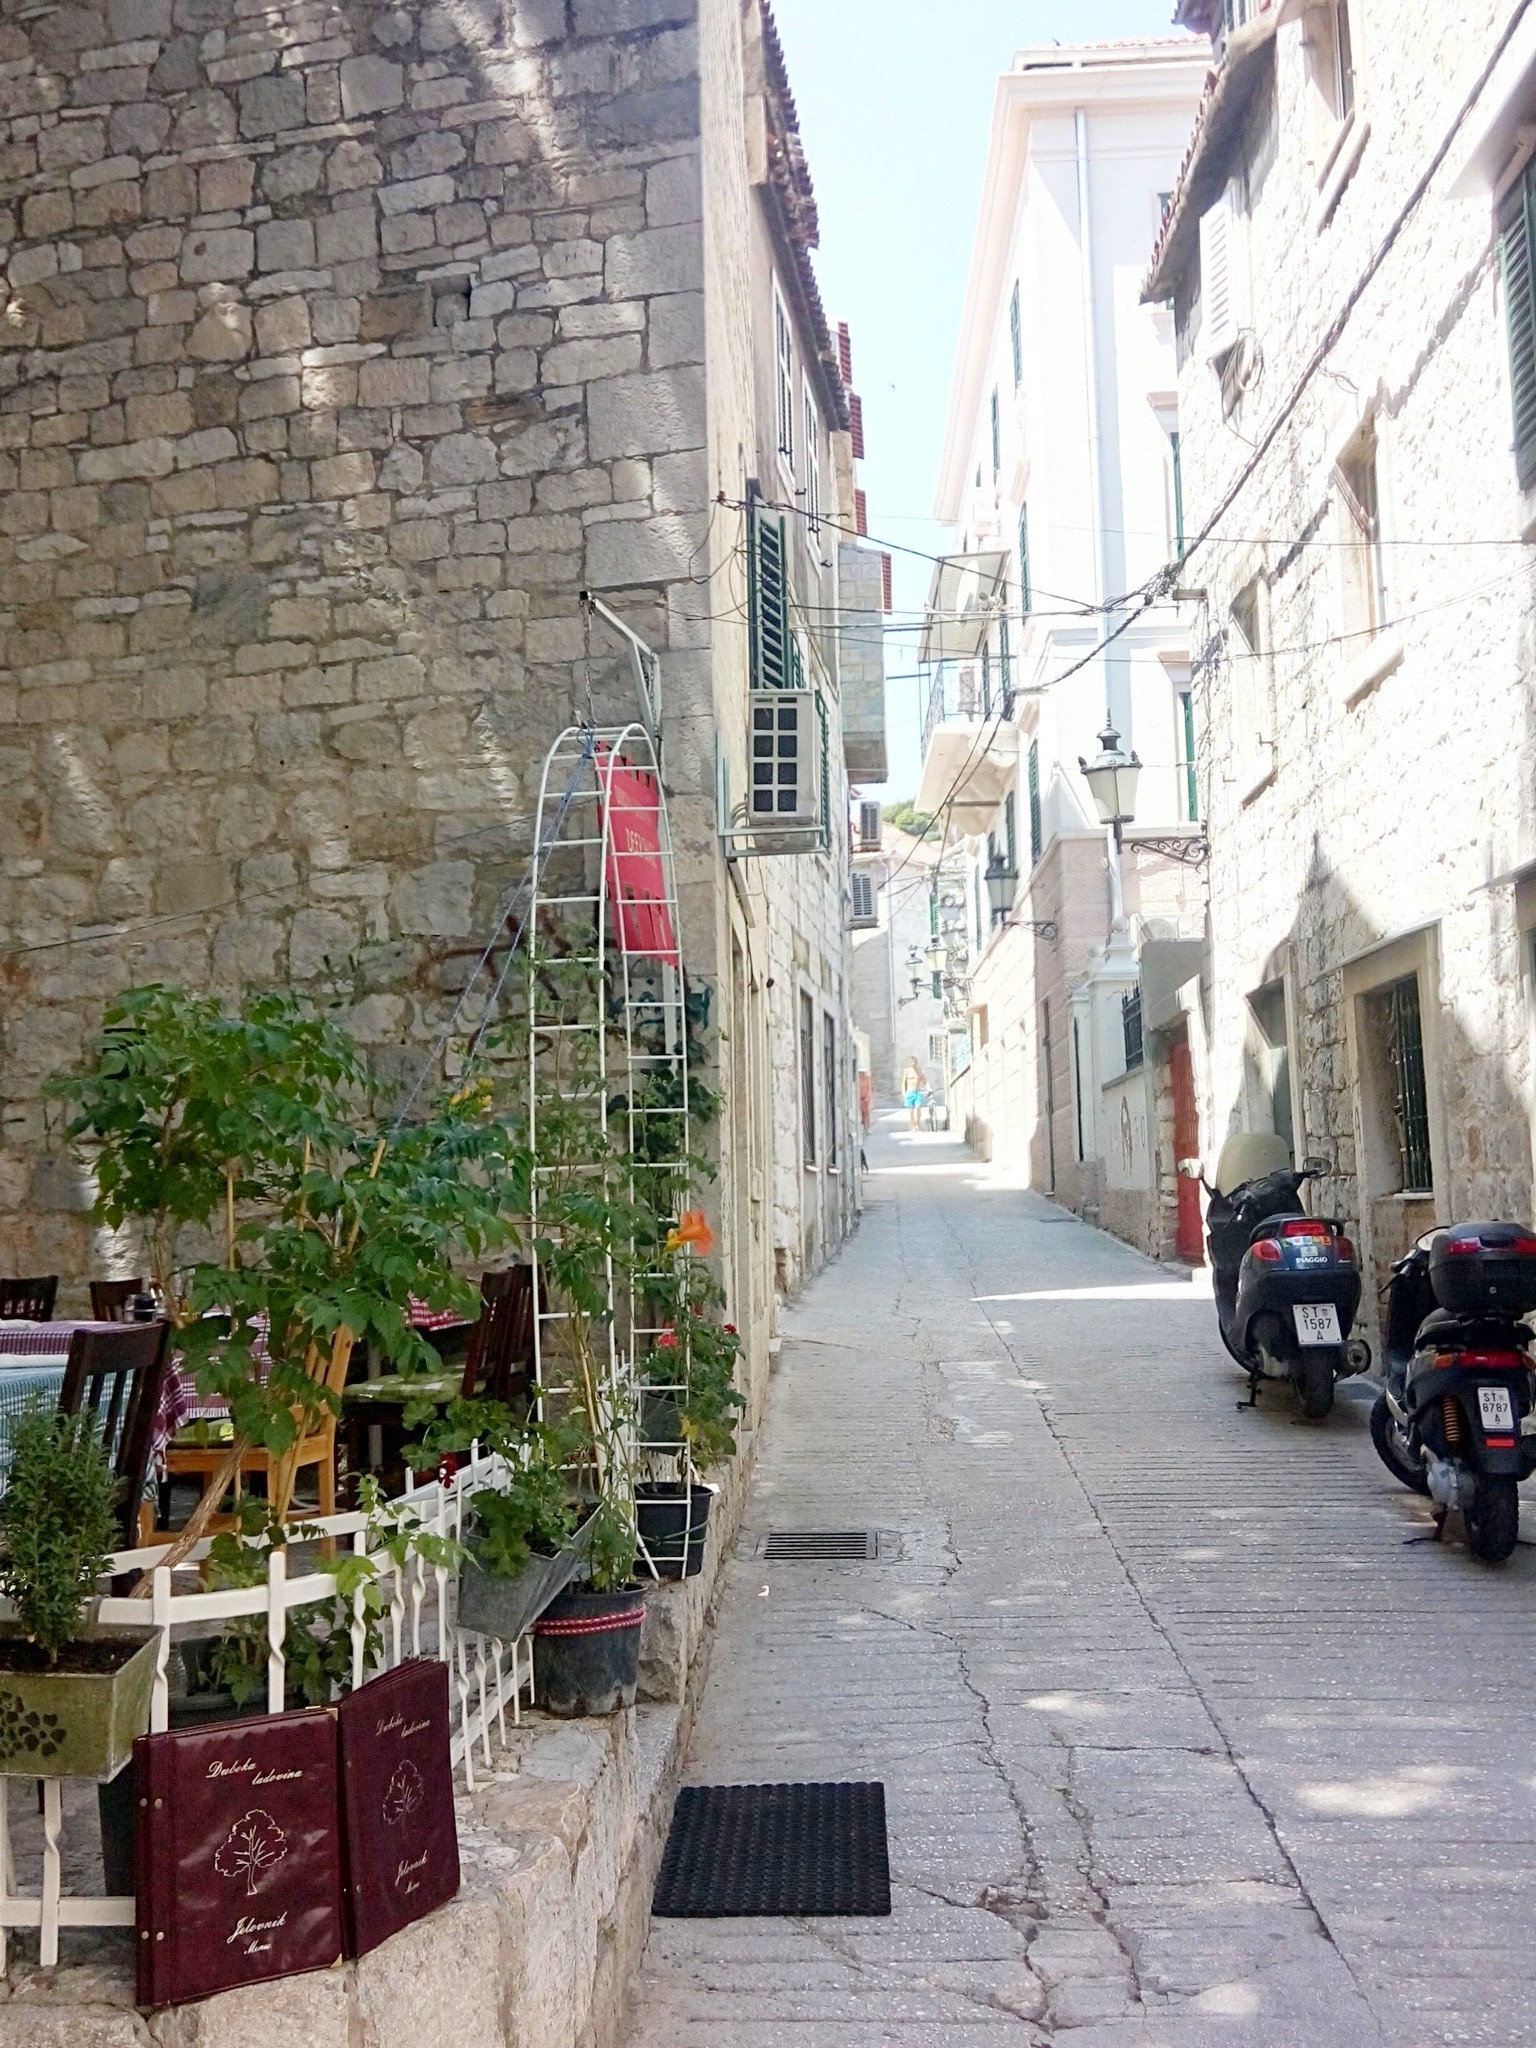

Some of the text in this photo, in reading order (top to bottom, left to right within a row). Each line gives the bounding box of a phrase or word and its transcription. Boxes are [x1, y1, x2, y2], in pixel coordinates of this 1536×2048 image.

[1295, 1256, 1328, 1264] PIAGGIO
[1302, 1306, 1318, 1318] ST
[1304, 1318, 1332, 1330] 1587
[1316, 1330, 1324, 1341] A
[1483, 1392, 1497, 1402] ST
[1482, 1402, 1508, 1413] 8787
[205, 1757, 257, 1779] Duboka
[252, 1768, 303, 1786] ladovina
[226, 1910, 288, 1944] Jelovnik
[243, 1940, 272, 1955] Menu
